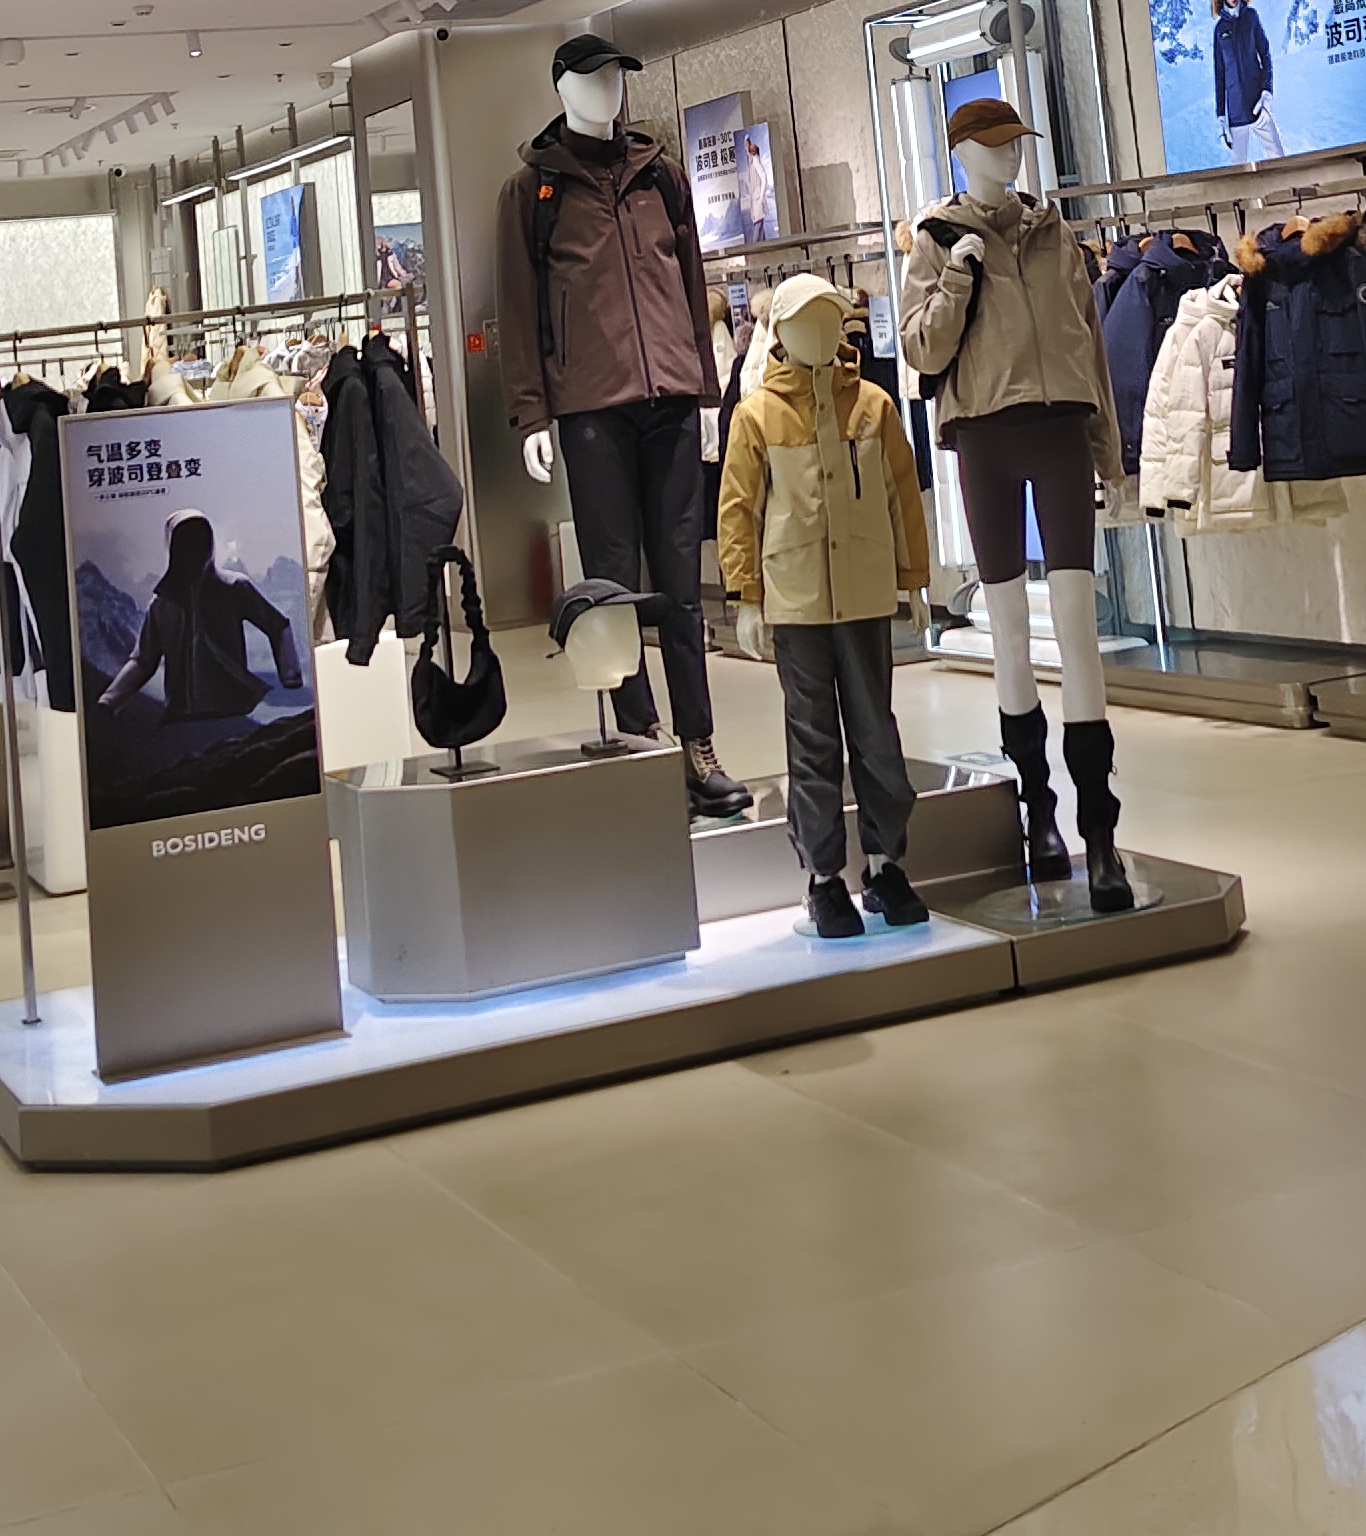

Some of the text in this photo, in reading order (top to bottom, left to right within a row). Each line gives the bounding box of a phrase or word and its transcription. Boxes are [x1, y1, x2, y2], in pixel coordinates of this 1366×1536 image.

[86, 438, 162, 464] 气温多变
[87, 458, 202, 488] 穿波司登叠变
[151, 823, 267, 858] BOSIDENG
